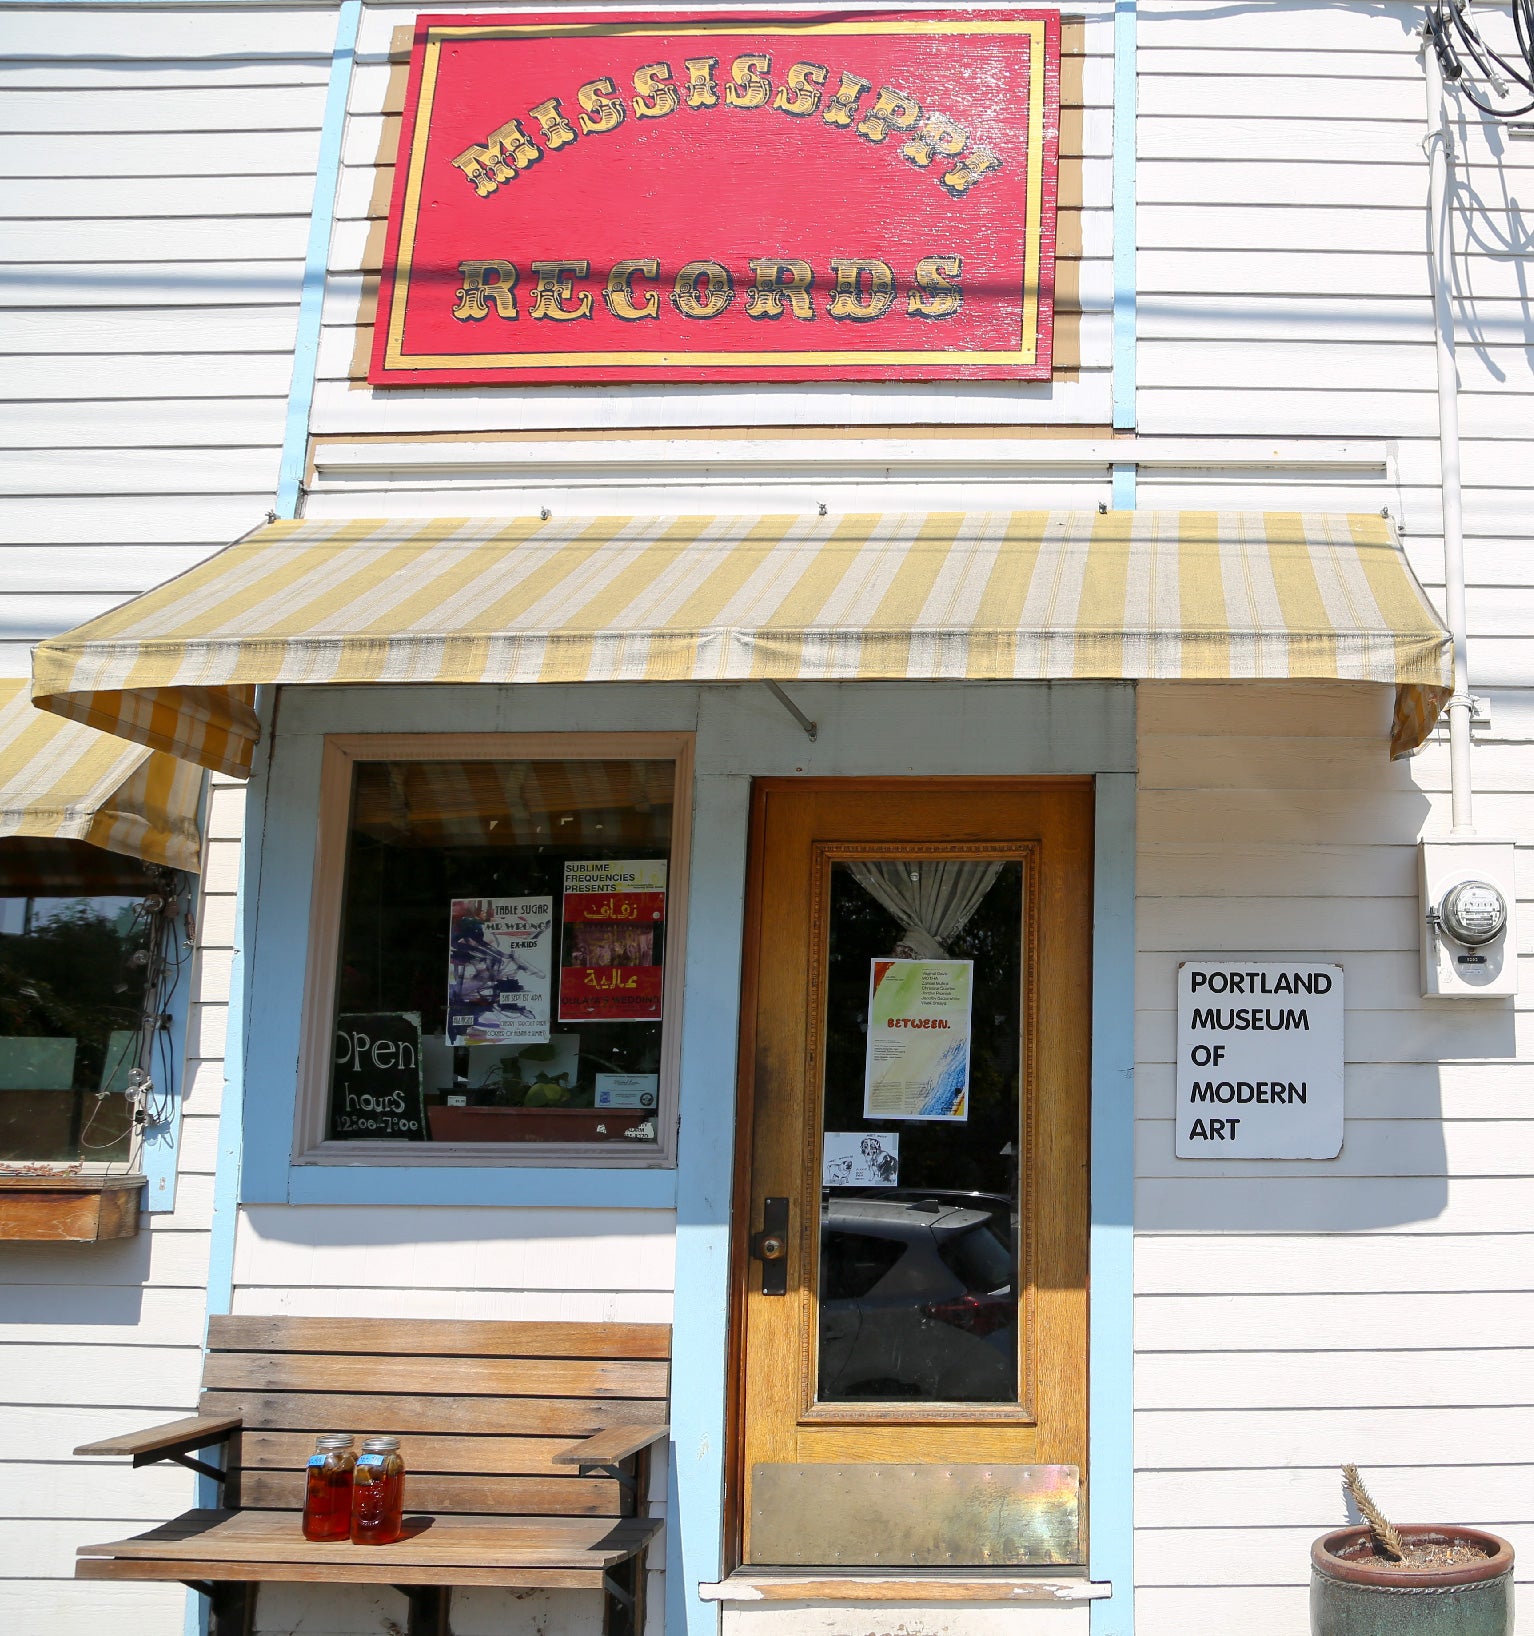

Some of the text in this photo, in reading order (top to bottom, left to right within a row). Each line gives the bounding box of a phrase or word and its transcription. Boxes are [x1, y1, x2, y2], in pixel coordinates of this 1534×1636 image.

[451, 53, 1003, 199] MISSISSIPPI
[453, 256, 965, 322] RECORDS
[565, 864, 610, 873] SUBLIME
[565, 873, 635, 882] FREQUENCIES
[564, 884, 617, 892] PRESENTS
[496, 904, 549, 915] TABLE SUGAR
[510, 941, 538, 949] EX-KIDS
[1191, 972, 1332, 994] PORTLAND
[887, 1018, 951, 1029] BETWEEN.
[1191, 1008, 1310, 1031] MUSEUM
[1191, 1045, 1225, 1067] OF
[1190, 1082, 1307, 1104] MODERN
[1189, 1118, 1241, 1140] ART
